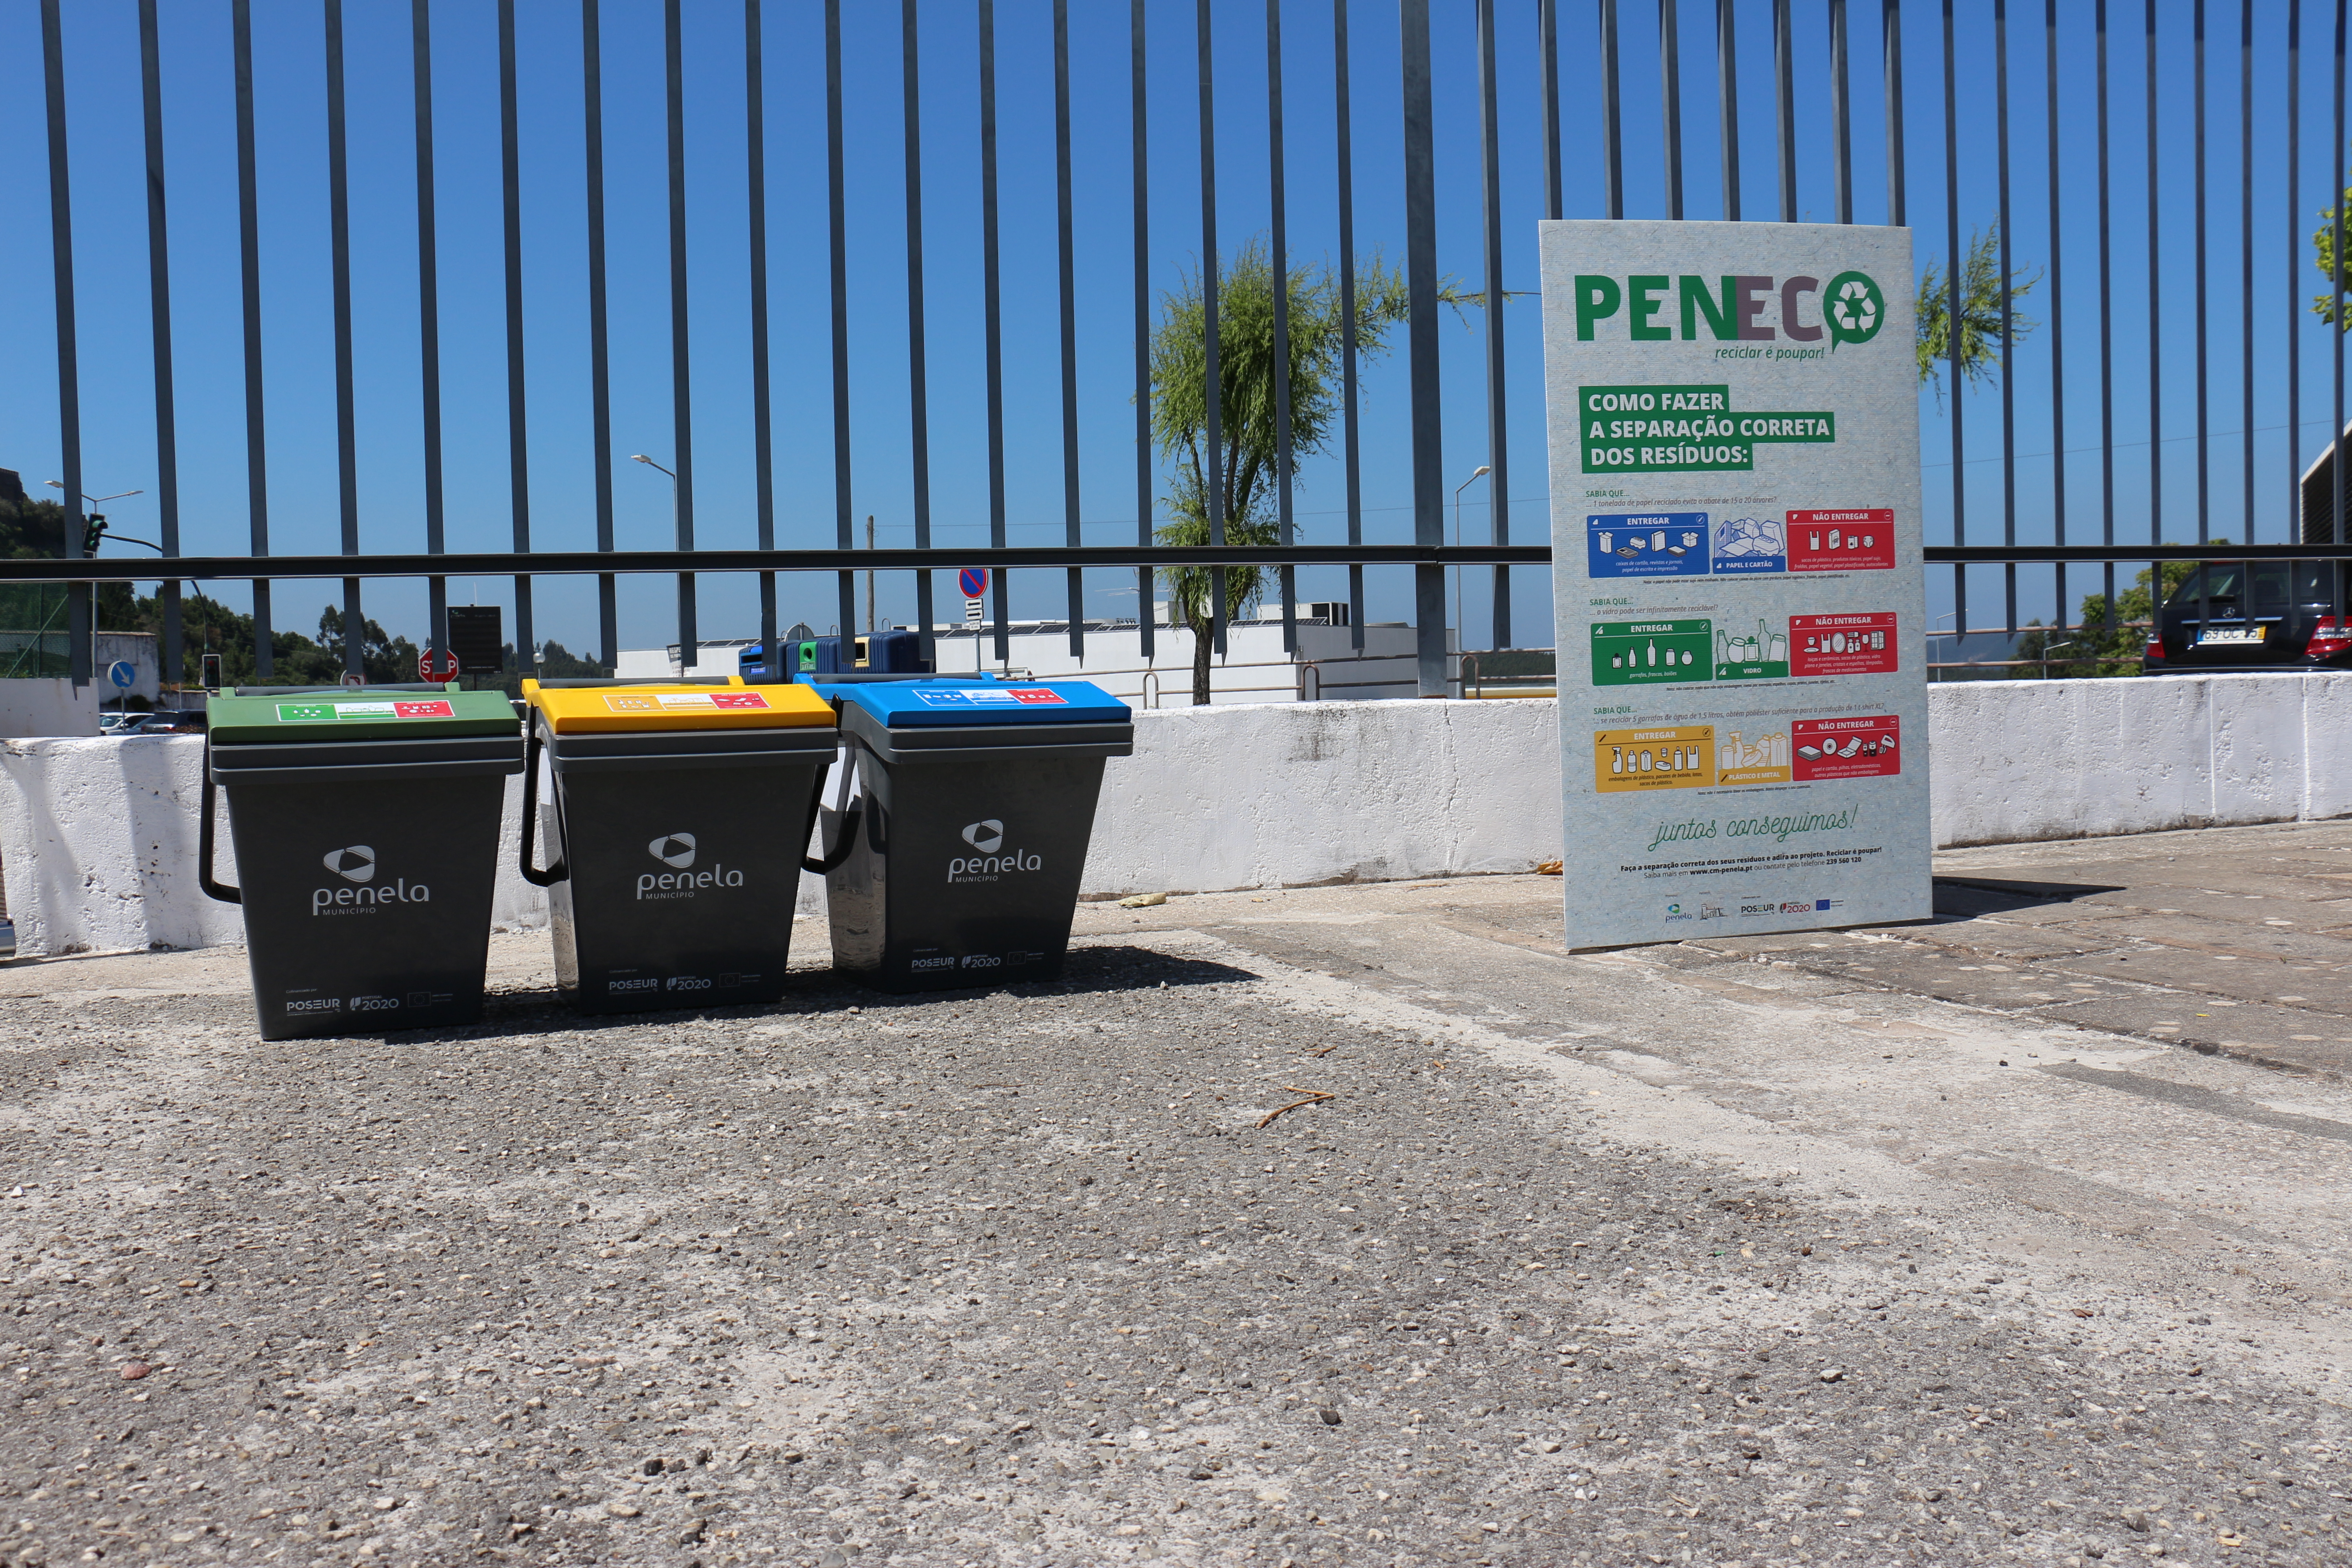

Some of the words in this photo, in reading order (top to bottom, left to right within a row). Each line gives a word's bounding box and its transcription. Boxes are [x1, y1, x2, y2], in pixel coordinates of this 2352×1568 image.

[1715, 347, 1763, 359] reciclar
[1766, 346, 1772, 359] é
[1775, 347, 1824, 362] poupar!
[1588, 393, 1655, 412] COMO
[1662, 393, 1725, 411] FAZER
[1590, 421, 1605, 439] A
[1610, 415, 1735, 442] SEPARAÇÃO
[1740, 419, 1830, 437] CORRETA
[1591, 448, 1634, 466] DOS
[1641, 442, 1748, 465] RESÍDUOS:
[1608, 489, 1630, 498] QUE...
[1636, 498, 1653, 507] papel
[1654, 497, 1682, 505] reciclado
[1752, 495, 1777, 505] árvores?
[1627, 517, 1670, 525] ENTREGAR
[1813, 512, 1829, 520] NÃO
[1619, 607, 1635, 616] pode
[1646, 605, 1687, 615] infinitamente
[1687, 603, 1718, 612] reciclável?
[1815, 616, 1832, 625] NÃO
[1834, 616, 1871, 624] ENTREGAR
[1631, 624, 1673, 633] ENTREGAR
[2205, 627, 2258, 639] 69-OC-5
[421, 660, 456, 674] SP
[1616, 706, 1637, 714] QUE...
[1637, 714, 1663, 724] garrafas
[1673, 712, 1688, 721] água
[1708, 711, 1724, 719] litros,
[1745, 708, 1770, 718] poliéster
[1771, 707, 1798, 716] suficiente
[1799, 708, 1813, 716] para
[1818, 705, 1845, 714] produção
[1858, 702, 1874, 710] t-shirt
[1818, 720, 1835, 730] NÃO
[1837, 720, 1874, 729] ENTREGAR
[1634, 731, 1676, 740] ENTREGAR
[1729, 772, 1756, 780] PLÁSTICO
[1647, 818, 1717, 852] juntos
[1726, 803, 1858, 843] conseguimos!
[1644, 862, 1679, 871] separação
[1799, 851, 1825, 860] projeto.
[1857, 846, 1882, 855] poupar!
[947, 848, 1041, 883] penela
[1644, 869, 1661, 878] Saiba
[1690, 865, 1753, 875] www.cm-penela.pt
[1787, 861, 1799, 869] pelo
[637, 863, 743, 900] penela
[313, 878, 429, 916] penela
[646, 891, 695, 899] MUNICÍPIO
[323, 906, 376, 916] MUNICÍPIO
[1741, 904, 1774, 913] POSEUR
[1787, 904, 1810, 913] 2020
[1666, 912, 1692, 923] penela
[911, 957, 955, 968] POSEUR
[971, 957, 1001, 968] 2020
[609, 979, 658, 990] POSEUR
[677, 979, 711, 990] 2020
[287, 999, 340, 1011] POSEUR
[362, 999, 399, 1010] 2020
